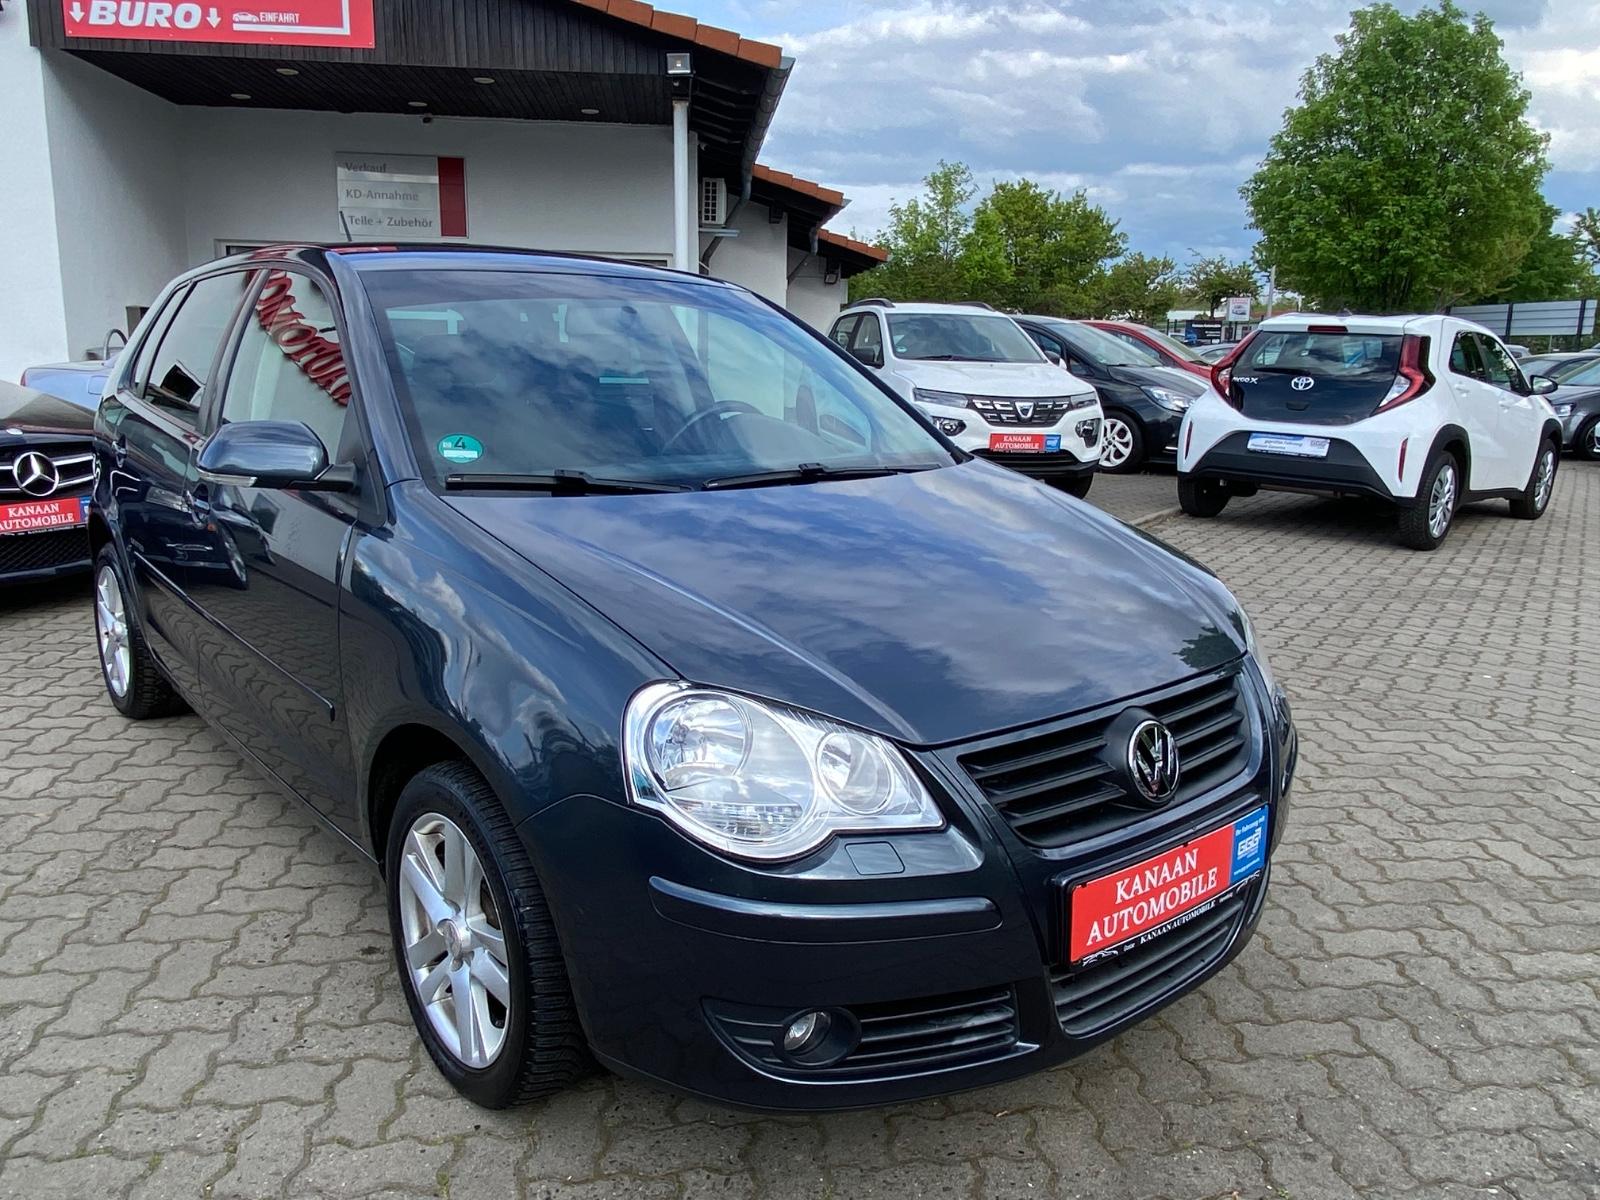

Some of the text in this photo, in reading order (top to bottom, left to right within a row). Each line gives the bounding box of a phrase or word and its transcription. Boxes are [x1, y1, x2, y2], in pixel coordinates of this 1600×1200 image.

[259, 11, 300, 24] EINFAHRT
[344, 162, 387, 174] Verkauf
[345, 188, 419, 202] KD-Annahme
[348, 215, 374, 227] Teile
[386, 216, 433, 228] Zubehör
[453, 436, 466, 450] 4
[1003, 434, 1032, 442] KANAAN
[994, 442, 1040, 450] AUTOMOBILE
[8, 502, 60, 518] KANAAN
[0, 512, 75, 531] AUTOMOBILE
[1115, 847, 1200, 905] KANAAN
[1085, 866, 1219, 947] AUTOMOBILE
[1140, 899, 1216, 945] KANAAN AUTOMOBILE
